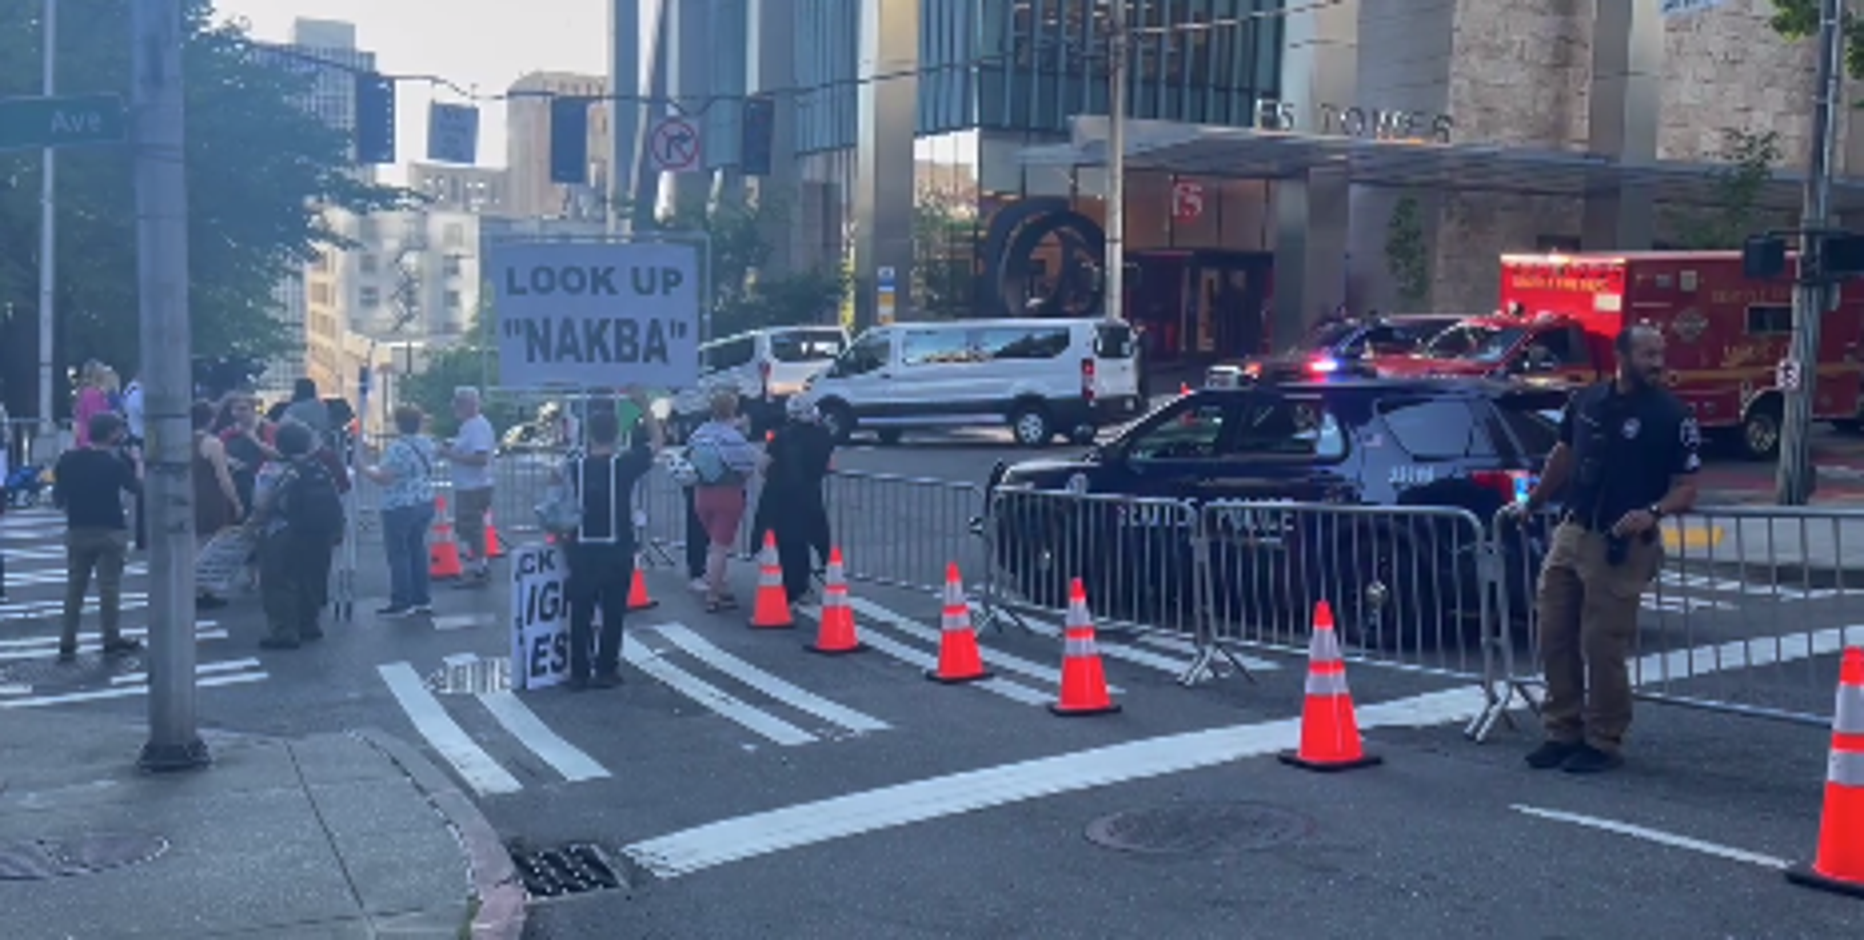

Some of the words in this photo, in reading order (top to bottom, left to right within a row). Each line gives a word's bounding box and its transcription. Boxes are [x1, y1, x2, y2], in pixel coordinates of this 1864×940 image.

[51, 110, 101, 133] Ave
[505, 265, 619, 296] LOOK
[630, 265, 683, 296] UP
[504, 316, 688, 365] "NAKBA"
